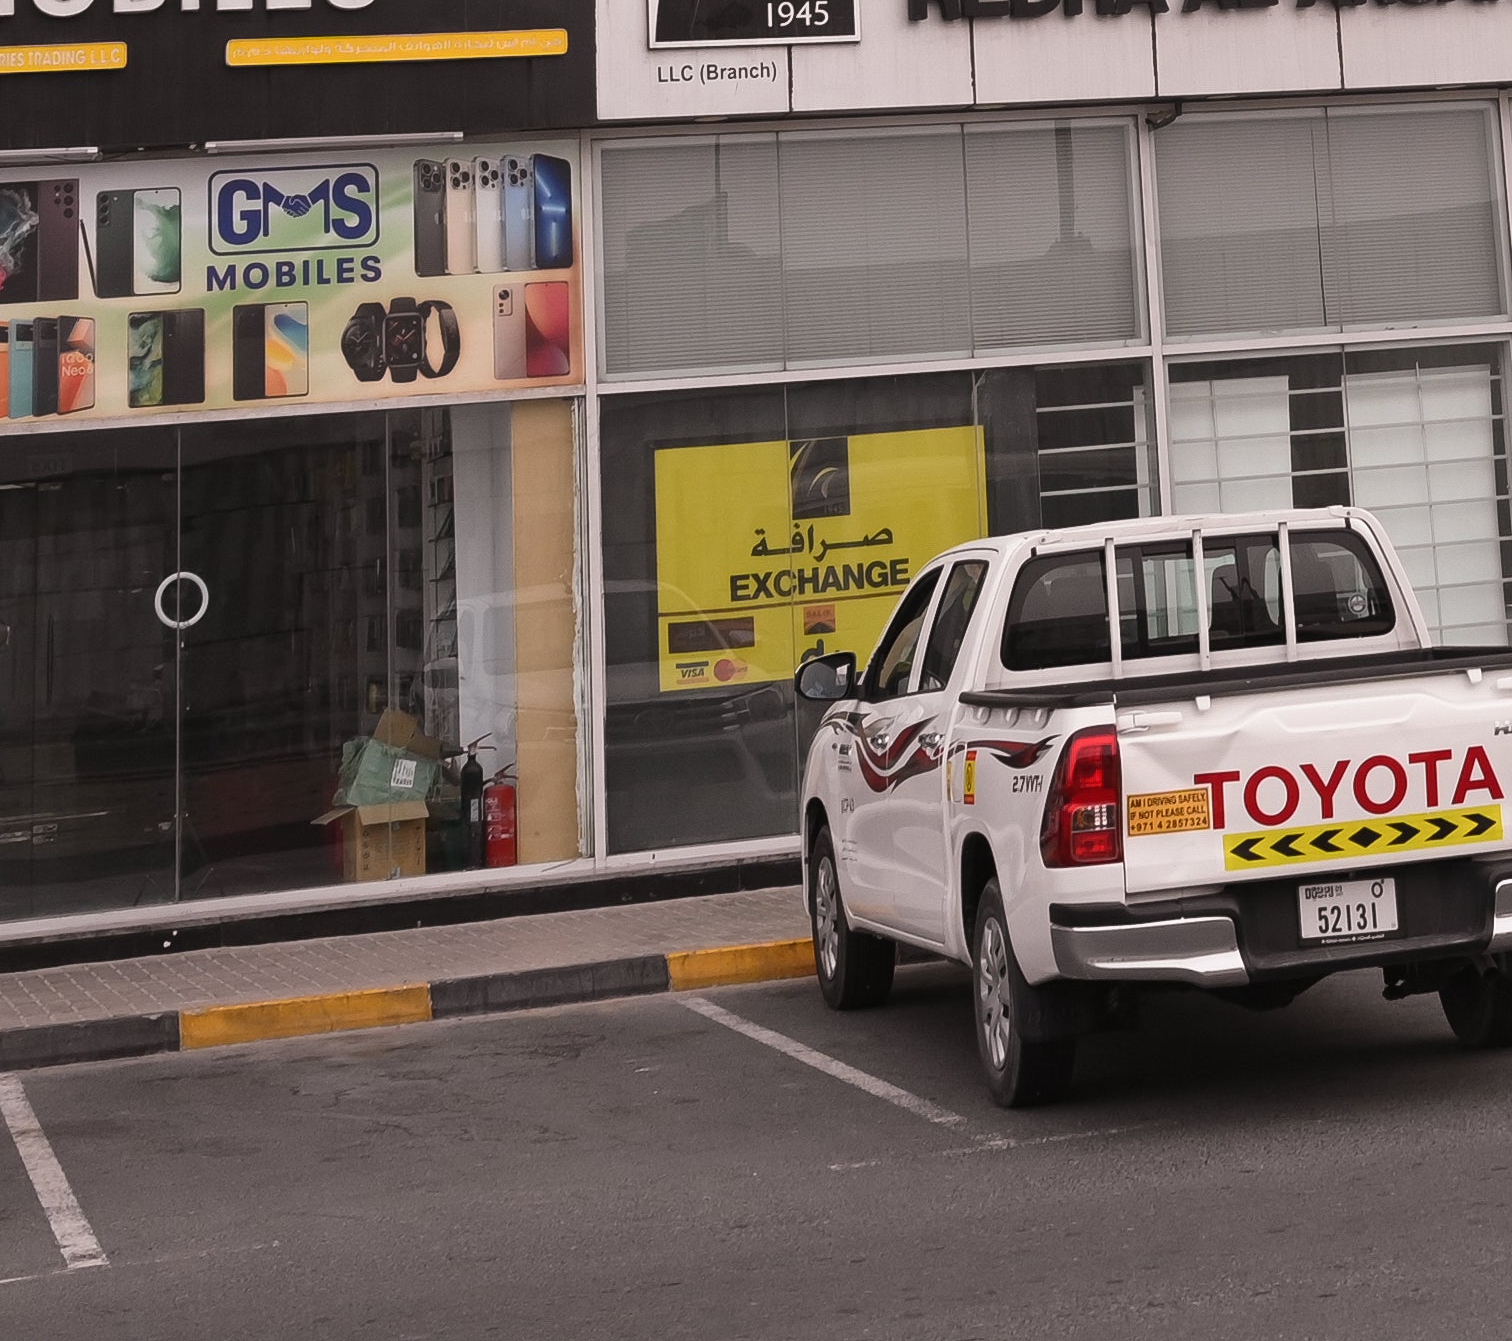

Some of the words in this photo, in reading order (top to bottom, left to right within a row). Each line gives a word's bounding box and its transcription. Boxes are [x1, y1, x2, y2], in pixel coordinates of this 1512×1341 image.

[766, 0, 831, 29] 1945
[27, 49, 87, 67] TRADING
[657, 64, 695, 84] LLC
[699, 61, 778, 84] (Branch)
[205, 253, 384, 294] MOBILES
[750, 521, 895, 563] صرافة
[729, 557, 912, 603] EXCHANGE
[680, 667, 706, 680] VISA
[1130, 798, 1143, 809] AM
[1178, 792, 1207, 805] SAFELY
[1193, 743, 1506, 832] TOYOTA
[1138, 809, 1155, 820] NOT
[1155, 806, 1186, 819] PLEASE
[1186, 804, 1207, 816] CALL
[1317, 901, 1378, 935] 52131
